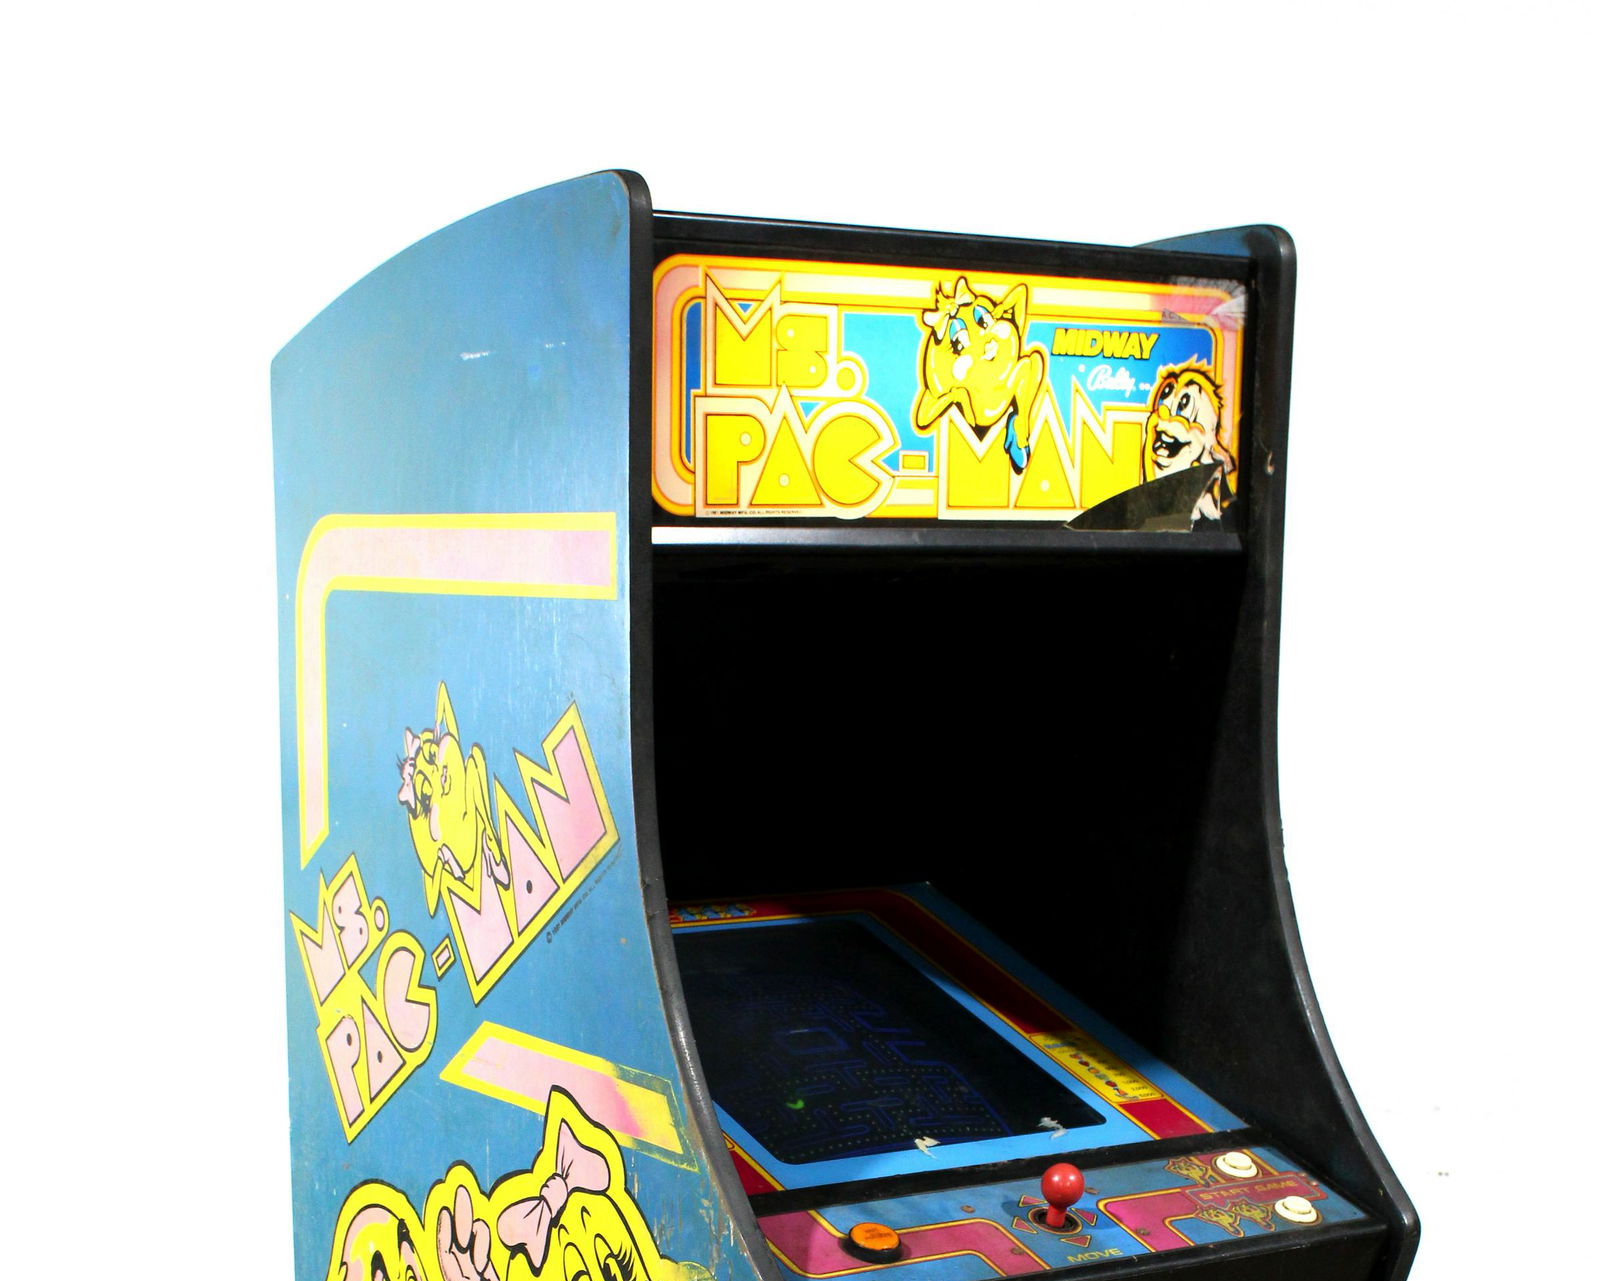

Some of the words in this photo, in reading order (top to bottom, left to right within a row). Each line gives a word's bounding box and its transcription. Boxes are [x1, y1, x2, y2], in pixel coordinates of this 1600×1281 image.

[704, 272, 864, 397] MS.
[1051, 327, 1160, 361] MIDWAY
[695, 378, 1152, 519] PAC-MAN
[290, 853, 389, 1007] MS.
[317, 702, 619, 1143] PAC-MAN
[1200, 1187, 1250, 1200] START
[1254, 1180, 1298, 1192] GAME
[1067, 1248, 1124, 1263] MOVE
